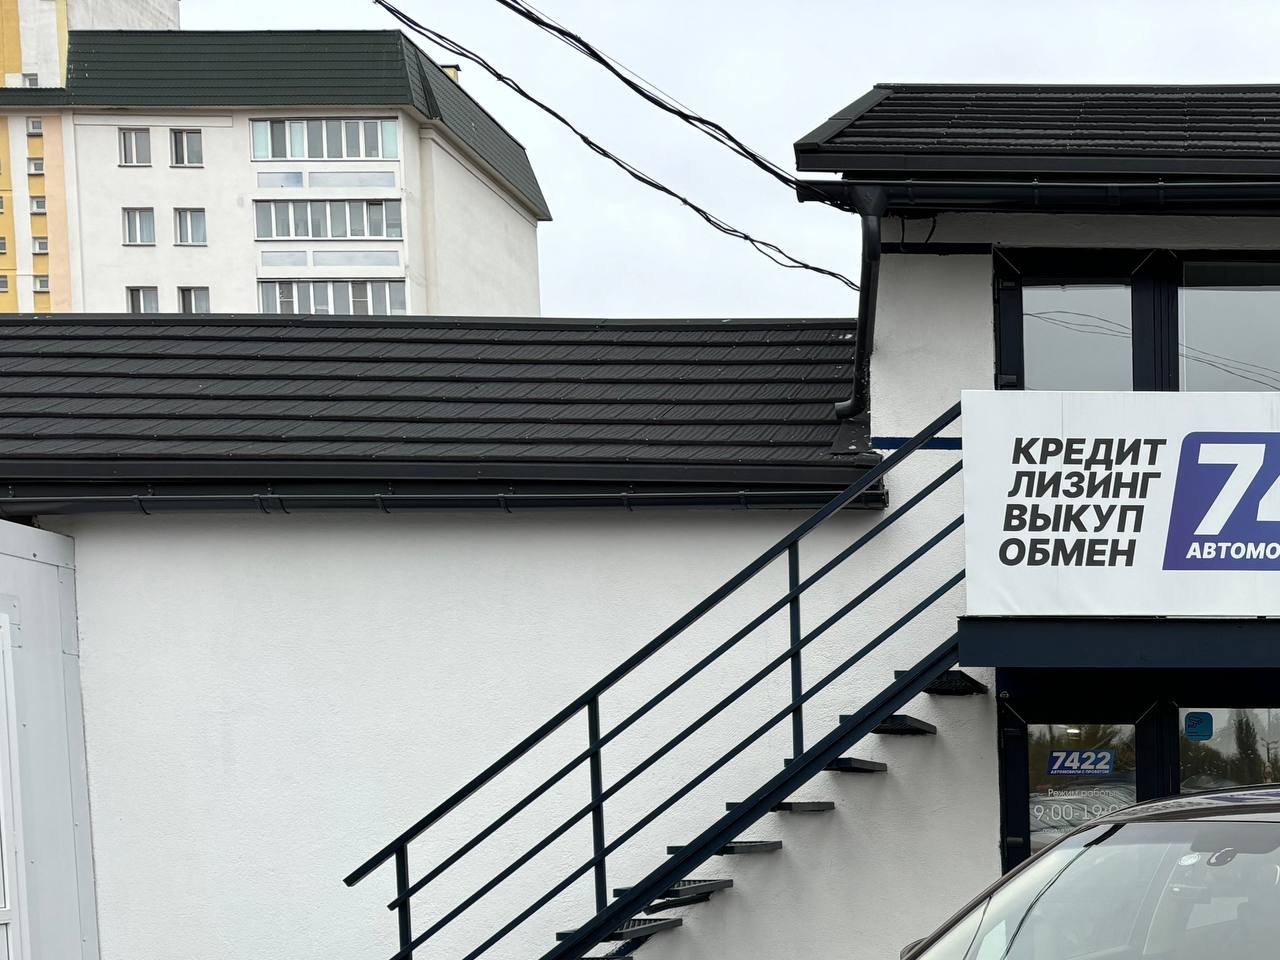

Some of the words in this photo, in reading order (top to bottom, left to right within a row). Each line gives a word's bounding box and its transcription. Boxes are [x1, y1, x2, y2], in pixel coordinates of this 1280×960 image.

[1011, 437, 1167, 471] КРЕДИТ
[1007, 471, 1162, 499] ЛИЗИНГ
[1003, 503, 1145, 533] ВЫКУП
[998, 537, 1137, 567] ОБМЕН
[1052, 751, 1111, 770] 7422
[1034, 804, 1120, 820] 9:00-19:
